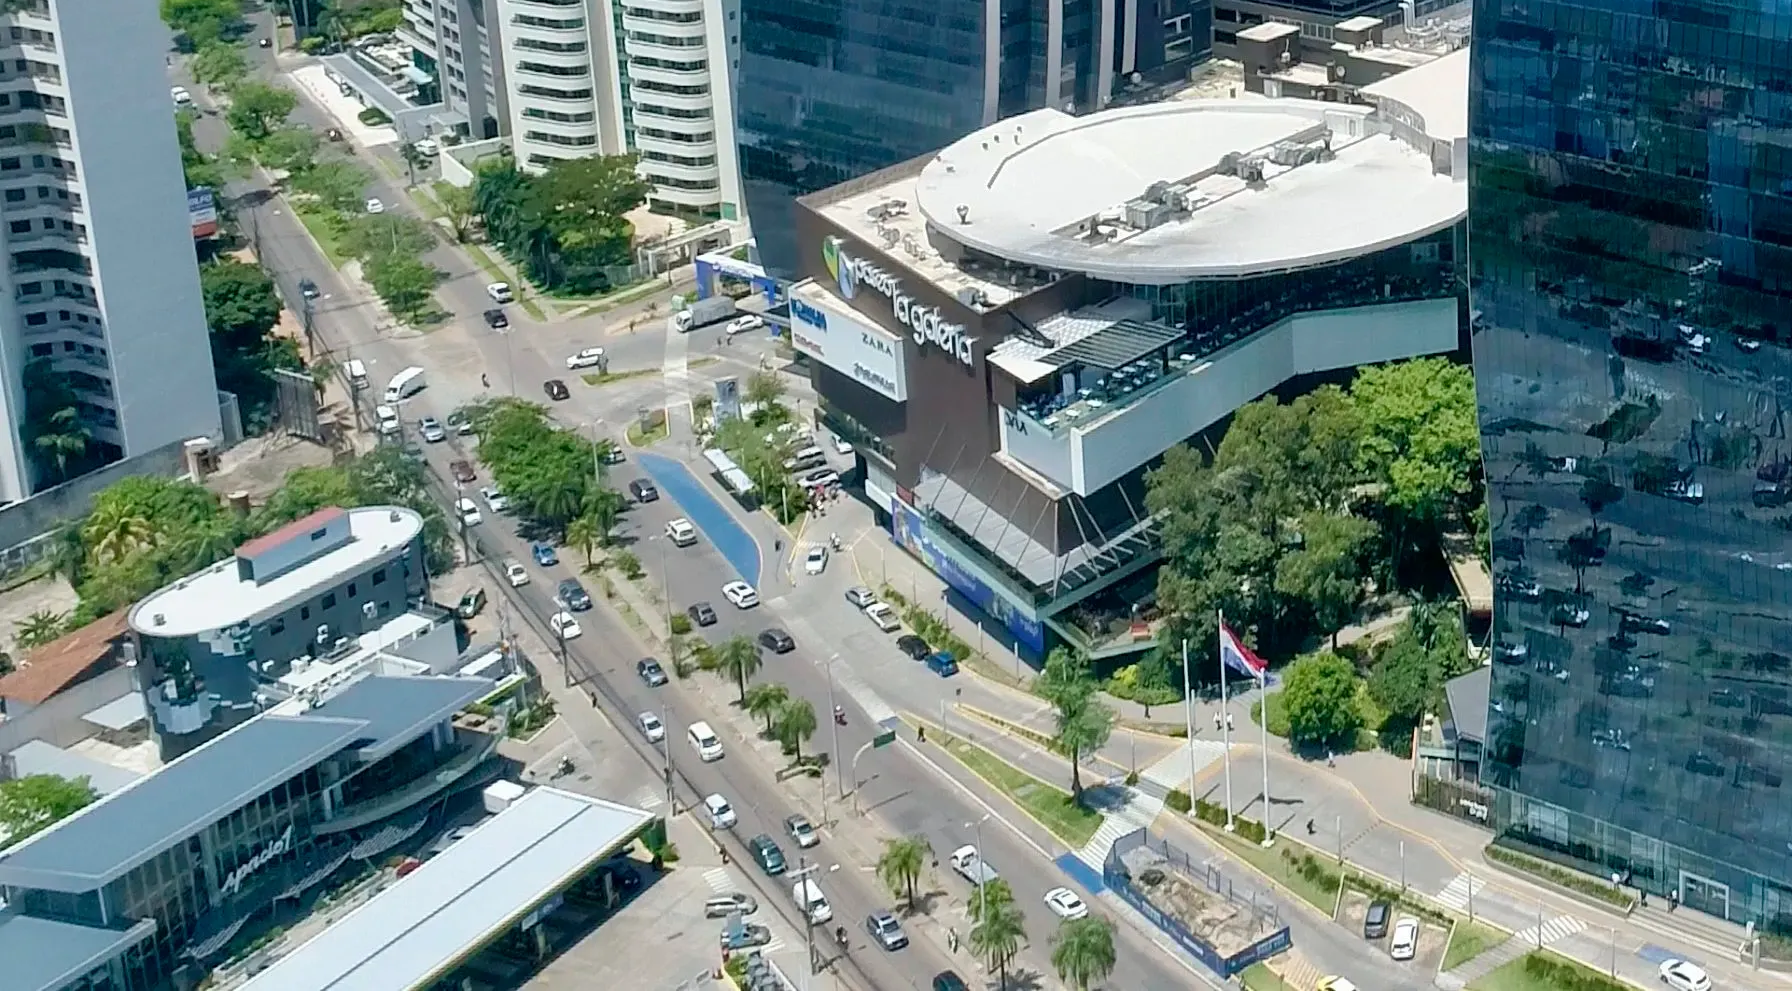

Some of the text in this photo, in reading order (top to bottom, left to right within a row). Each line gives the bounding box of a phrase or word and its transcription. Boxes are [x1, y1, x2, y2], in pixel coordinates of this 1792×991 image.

[861, 331, 894, 358] ZARA
[892, 281, 911, 326] la
[911, 305, 973, 366] galeria
